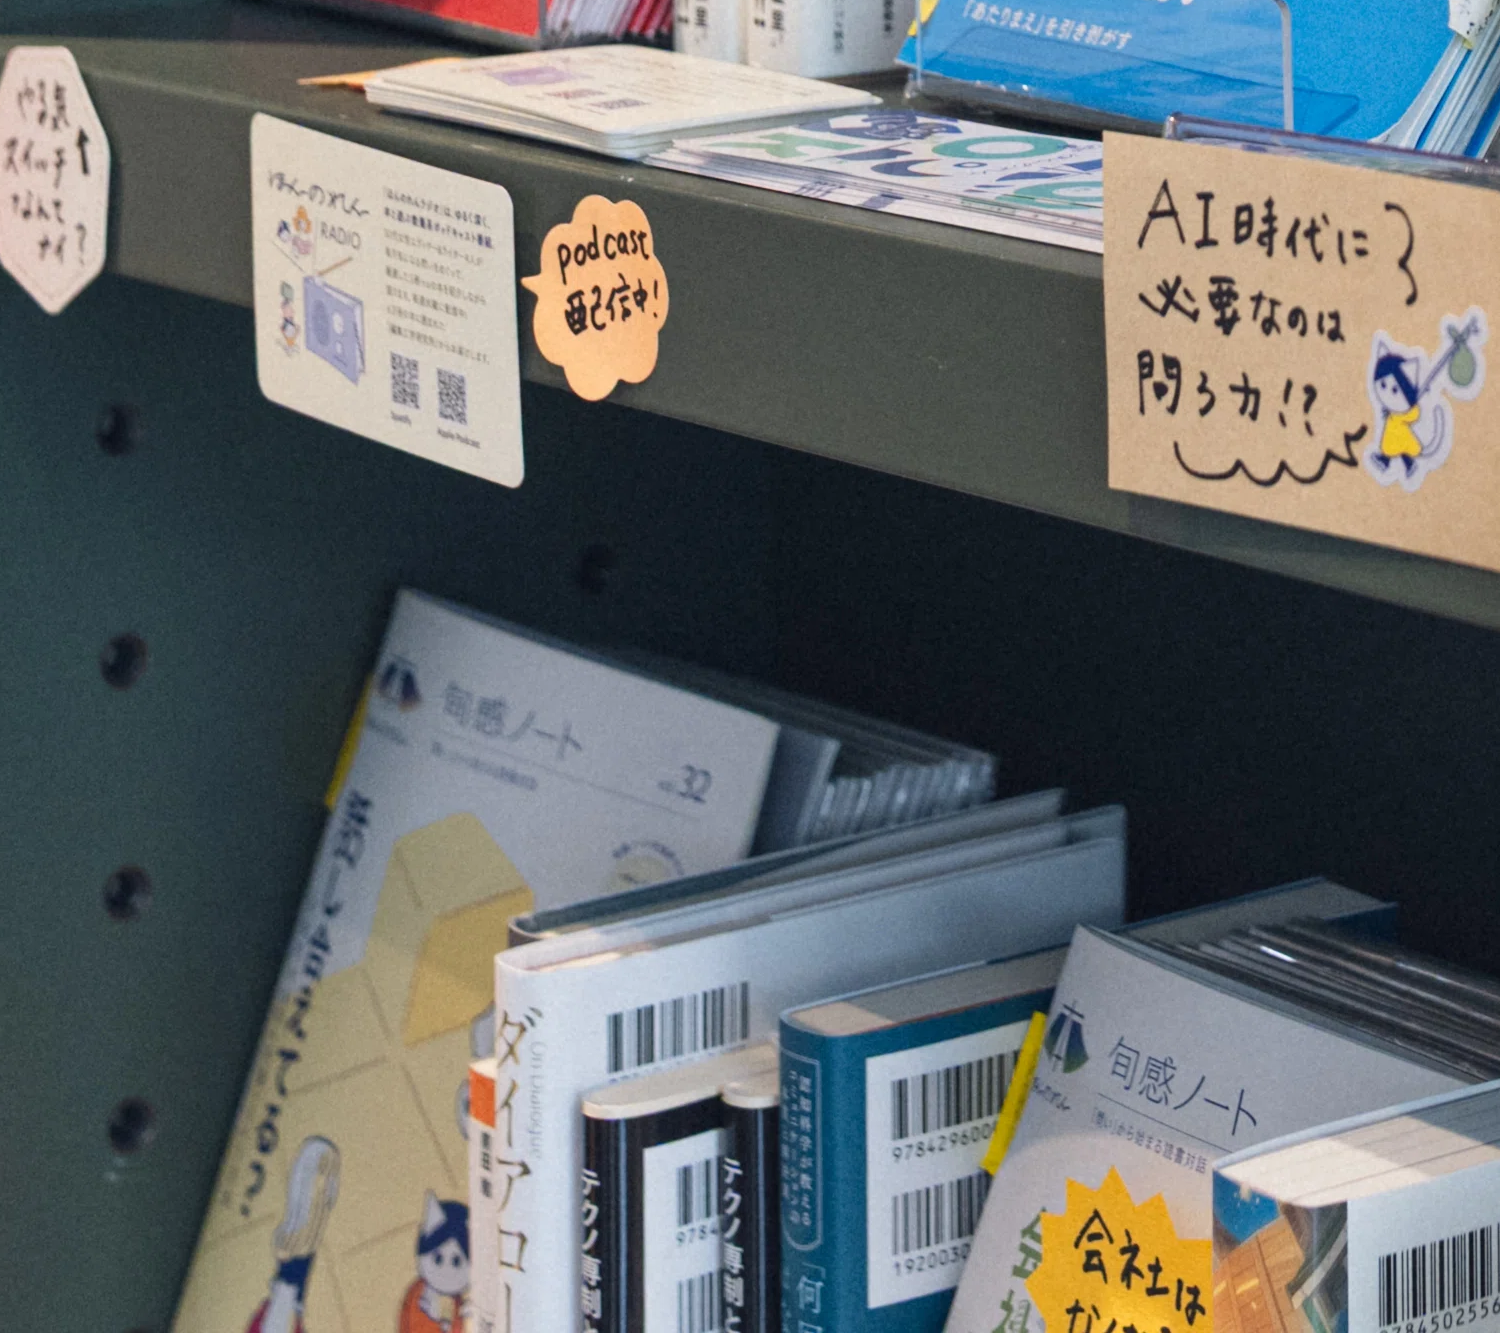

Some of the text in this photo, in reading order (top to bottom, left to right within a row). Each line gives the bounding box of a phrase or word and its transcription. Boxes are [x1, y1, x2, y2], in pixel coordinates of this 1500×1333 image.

[962, 2, 1133, 52] 「あたりまえ」を引き剥がす
[17, 78, 70, 131] やる気
[4, 137, 65, 188] スイッチ
[268, 171, 370, 217] ほんのれん
[1138, 179, 1369, 265] AI時代に
[320, 222, 361, 250] RADIO
[557, 226, 650, 284] podcast
[563, 280, 661, 337] 配信中！
[1139, 275, 1345, 343] 必要なのは
[441, 681, 584, 757] 旬感ノート
[1109, 1035, 1257, 1136] 旬感ノート
[892, 1119, 997, 1161] 978429600
[497, 1006, 543, 1333] ダイアロー
[1073, 1208, 1206, 1326] 会社は
